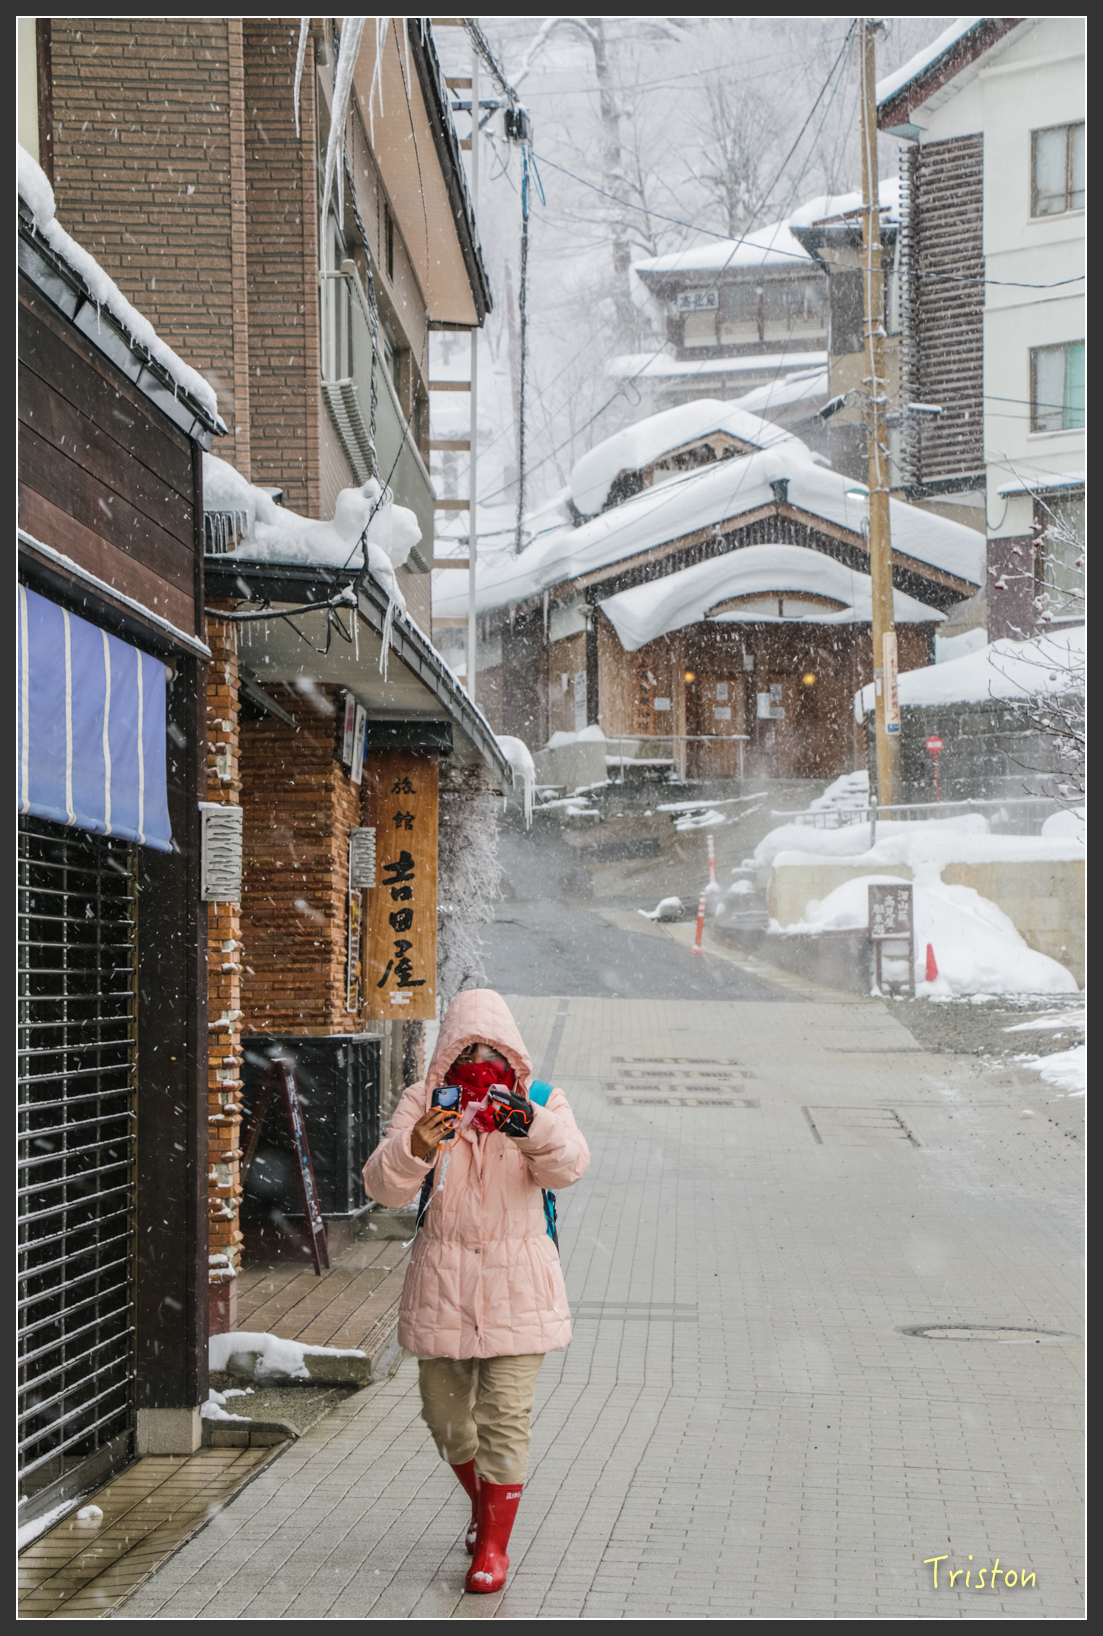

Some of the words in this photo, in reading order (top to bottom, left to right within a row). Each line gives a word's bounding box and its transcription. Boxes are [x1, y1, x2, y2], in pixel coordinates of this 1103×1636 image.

[391, 776, 417, 831] 旅館
[377, 850, 426, 988] 吉田屋
